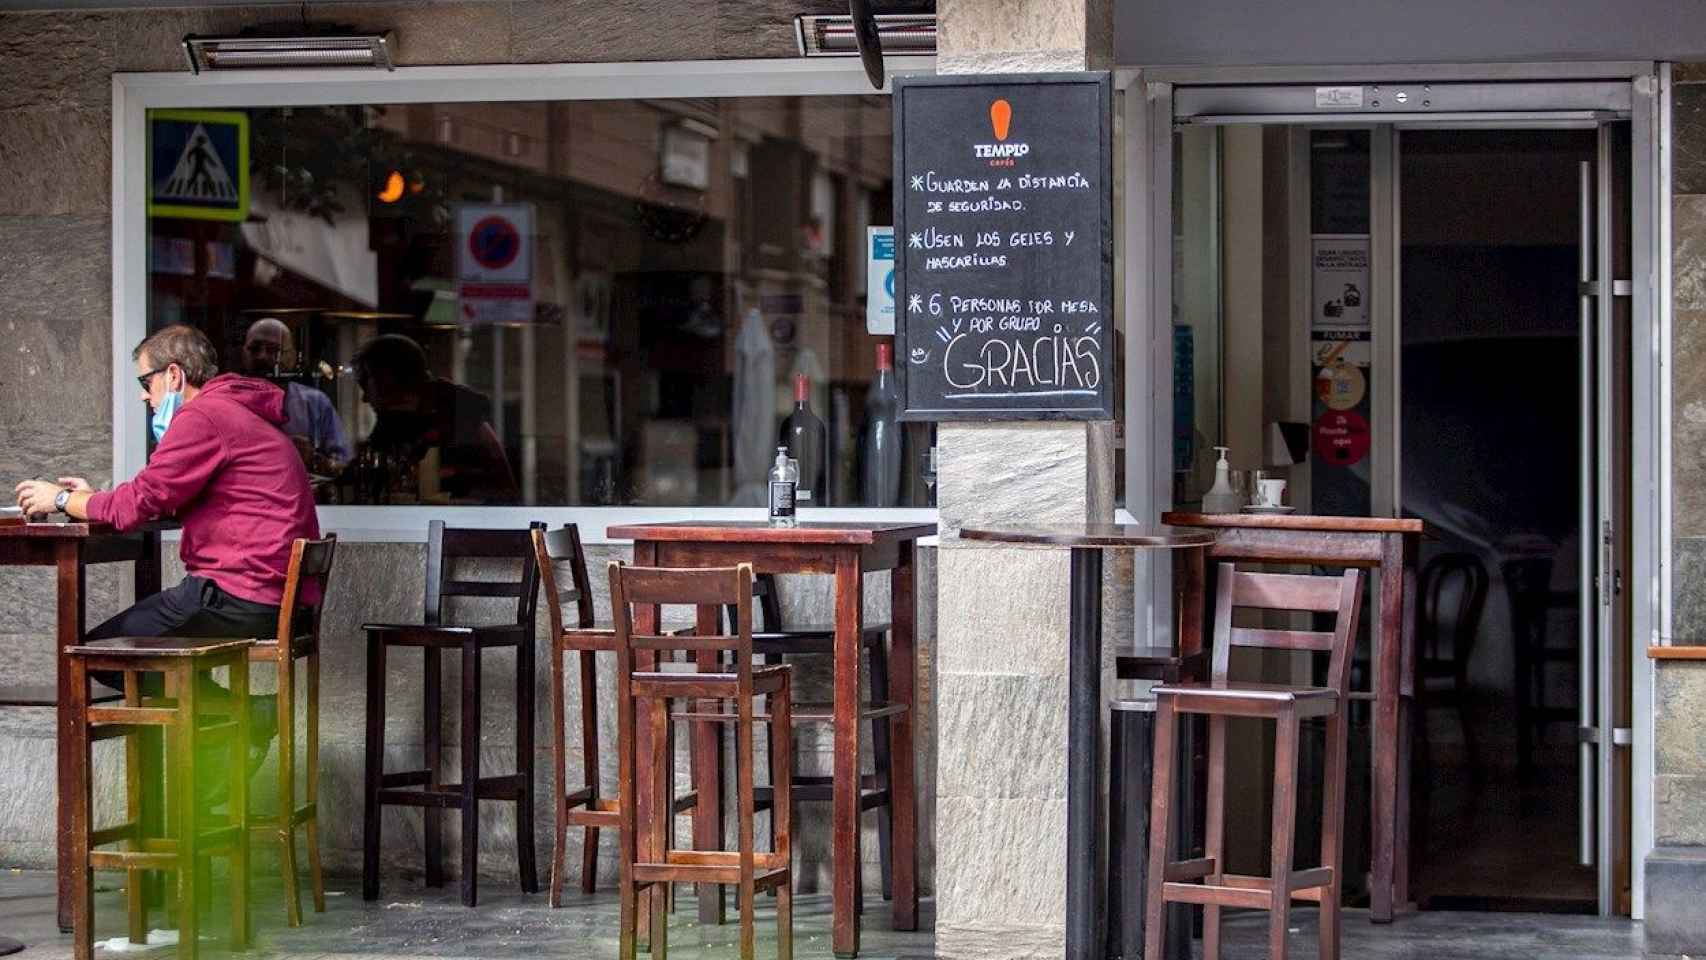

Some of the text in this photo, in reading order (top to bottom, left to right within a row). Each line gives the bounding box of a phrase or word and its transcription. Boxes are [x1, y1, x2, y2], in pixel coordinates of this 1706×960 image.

[974, 143, 1030, 158] TEMPLO
[926, 171, 990, 194] GUARDEN
[997, 178, 1012, 190] LA
[927, 201, 944, 213] DE
[924, 226, 964, 250] USEN
[975, 231, 1001, 248] LOS
[1064, 231, 1075, 247] Y
[926, 253, 1008, 271] MASCARILLAS
[928, 293, 942, 316] 6
[949, 295, 1022, 314] PERSONAS
[1061, 299, 1099, 314] MESA
[952, 315, 1041, 334] Y POR GRUPO
[943, 323, 1101, 389] GRACIAS
